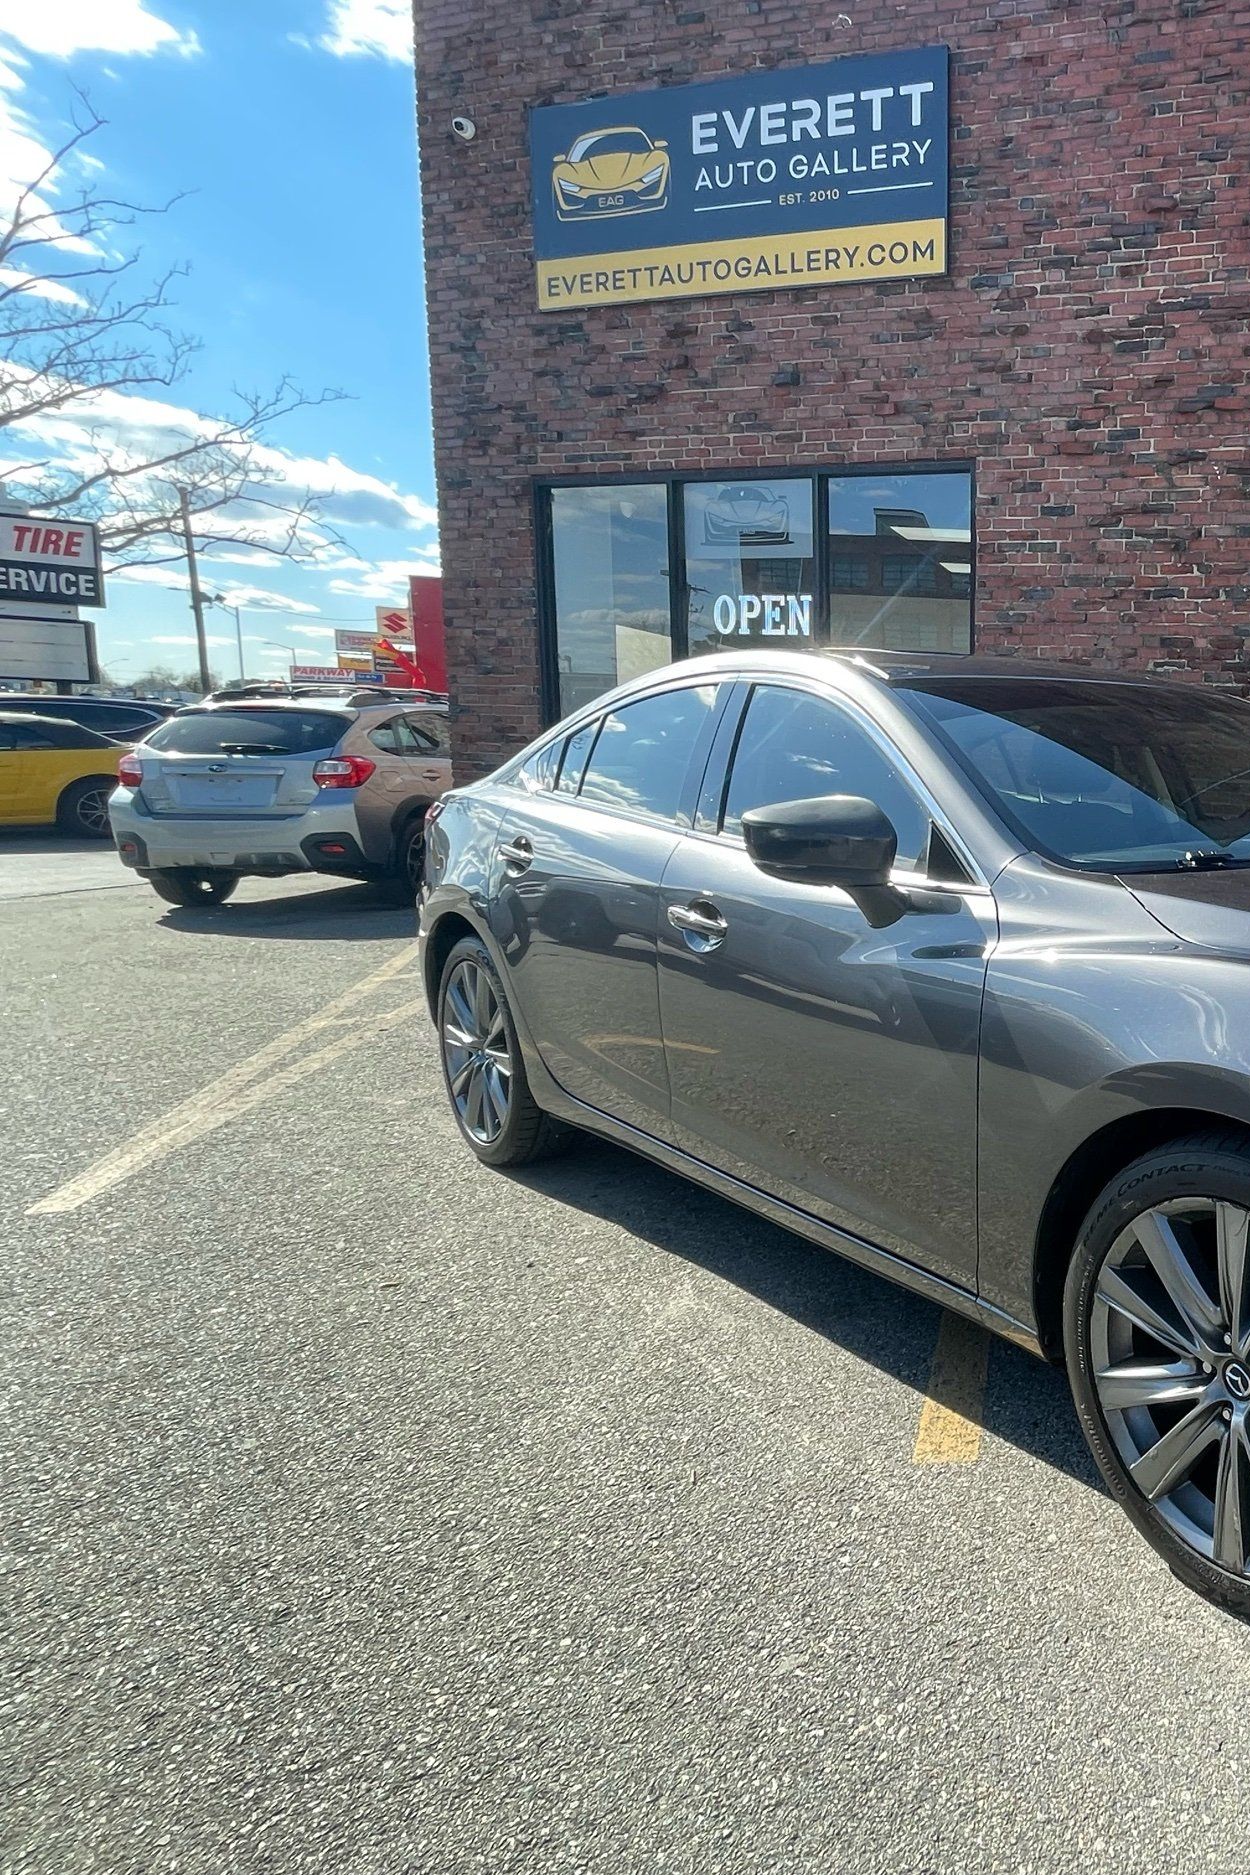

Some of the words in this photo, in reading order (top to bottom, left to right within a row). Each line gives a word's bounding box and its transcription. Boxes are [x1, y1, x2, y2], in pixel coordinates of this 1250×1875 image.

[691, 81, 935, 155] EVERETT
[694, 158, 777, 191] AUTO
[789, 138, 933, 178] GALLERY
[598, 195, 625, 208] EAG
[778, 192, 807, 206] EST.
[811, 188, 840, 203] 2010
[547, 238, 935, 298] EVERETTAUTOGALLERY.COM
[13, 525, 84, 557] TIRE
[712, 594, 812, 636] OPEN
[293, 667, 352, 676] PARKWAY
